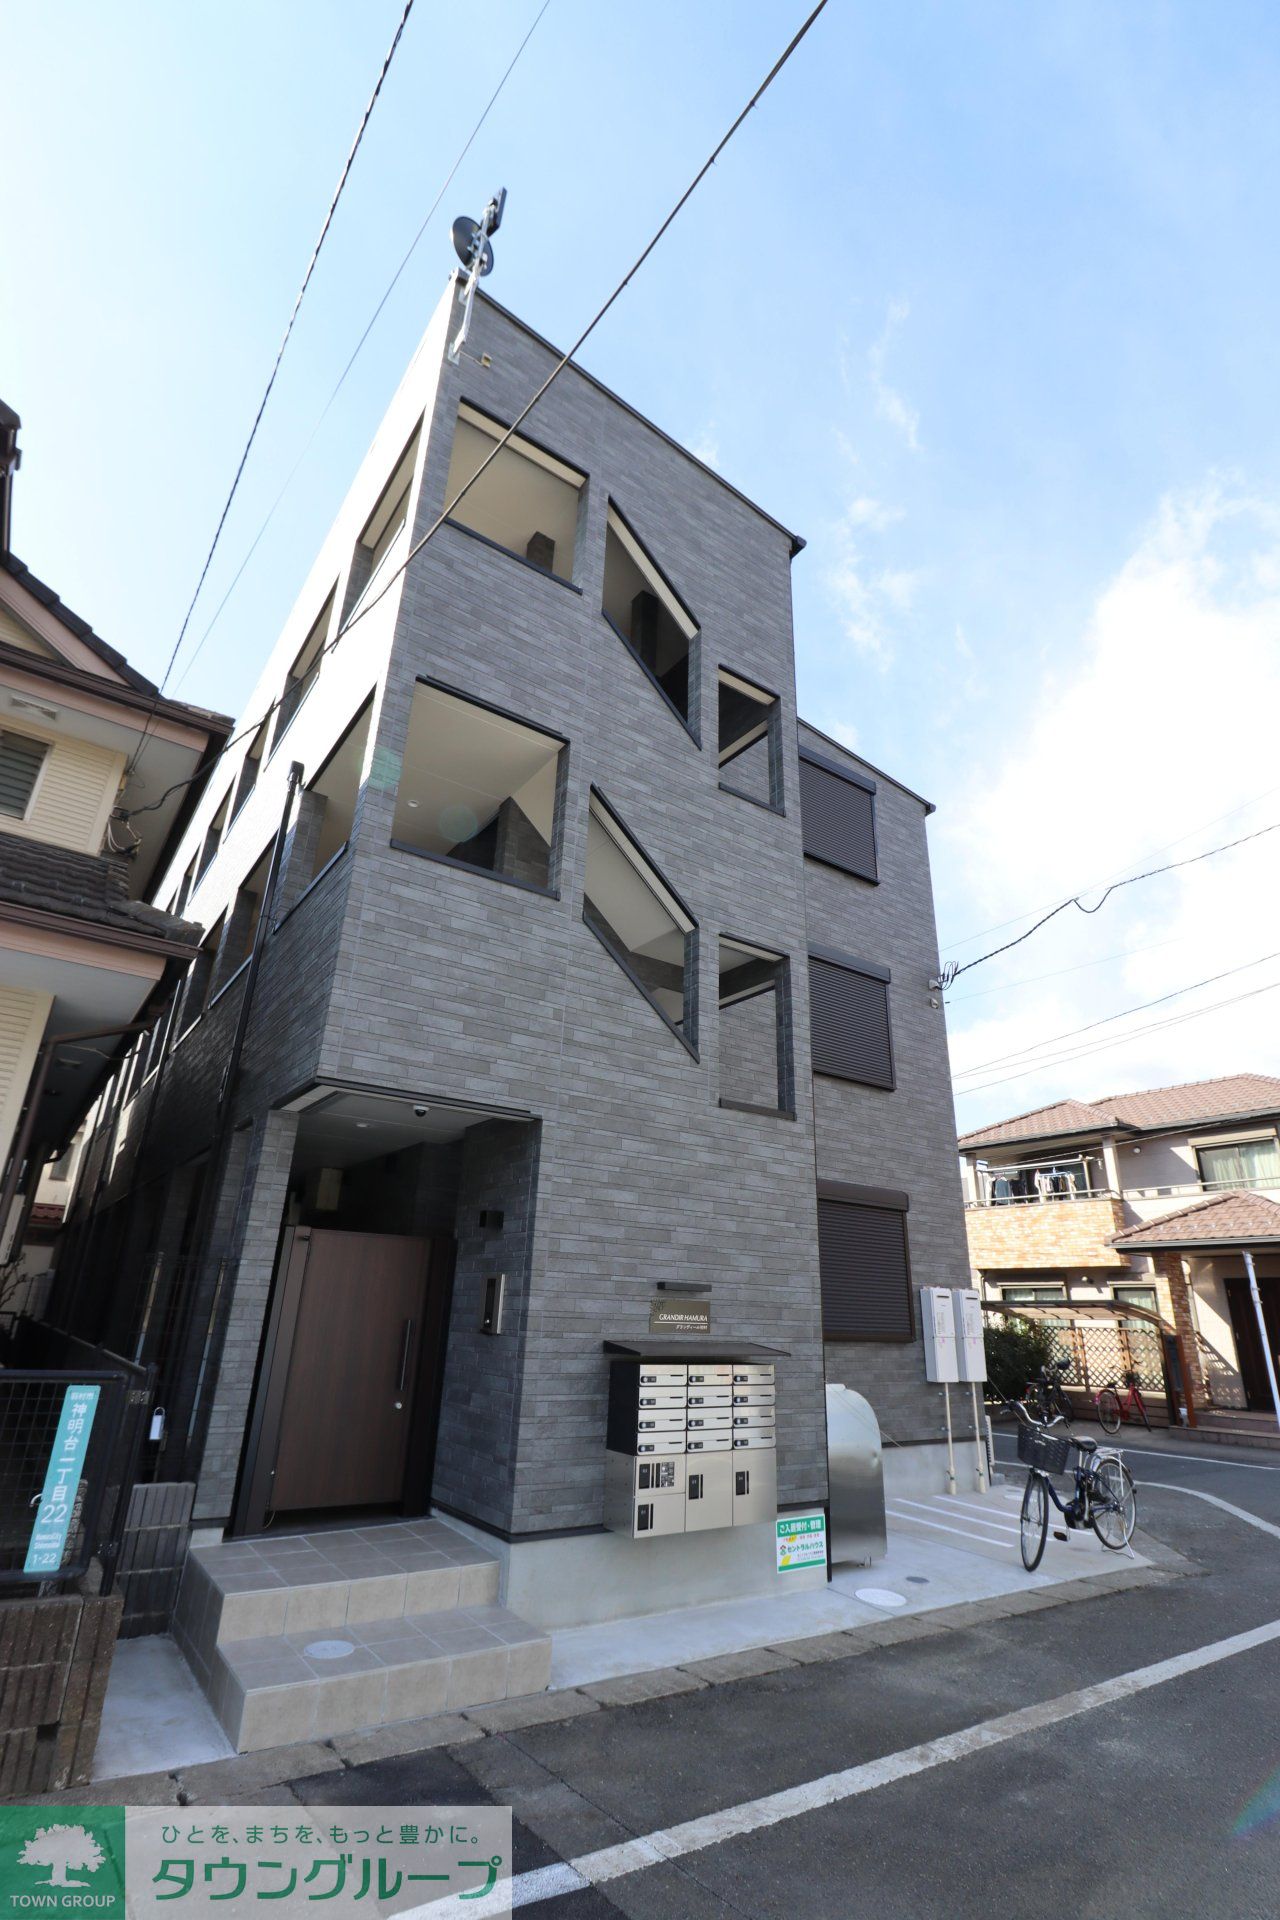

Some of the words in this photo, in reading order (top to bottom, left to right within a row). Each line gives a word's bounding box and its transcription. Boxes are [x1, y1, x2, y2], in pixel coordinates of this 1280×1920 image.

[659, 1313, 684, 1321] GRANDIR
[684, 1314, 708, 1322] HAMURA
[52, 1403, 88, 1501] 神明台一丁目
[40, 1504, 68, 1523] 22
